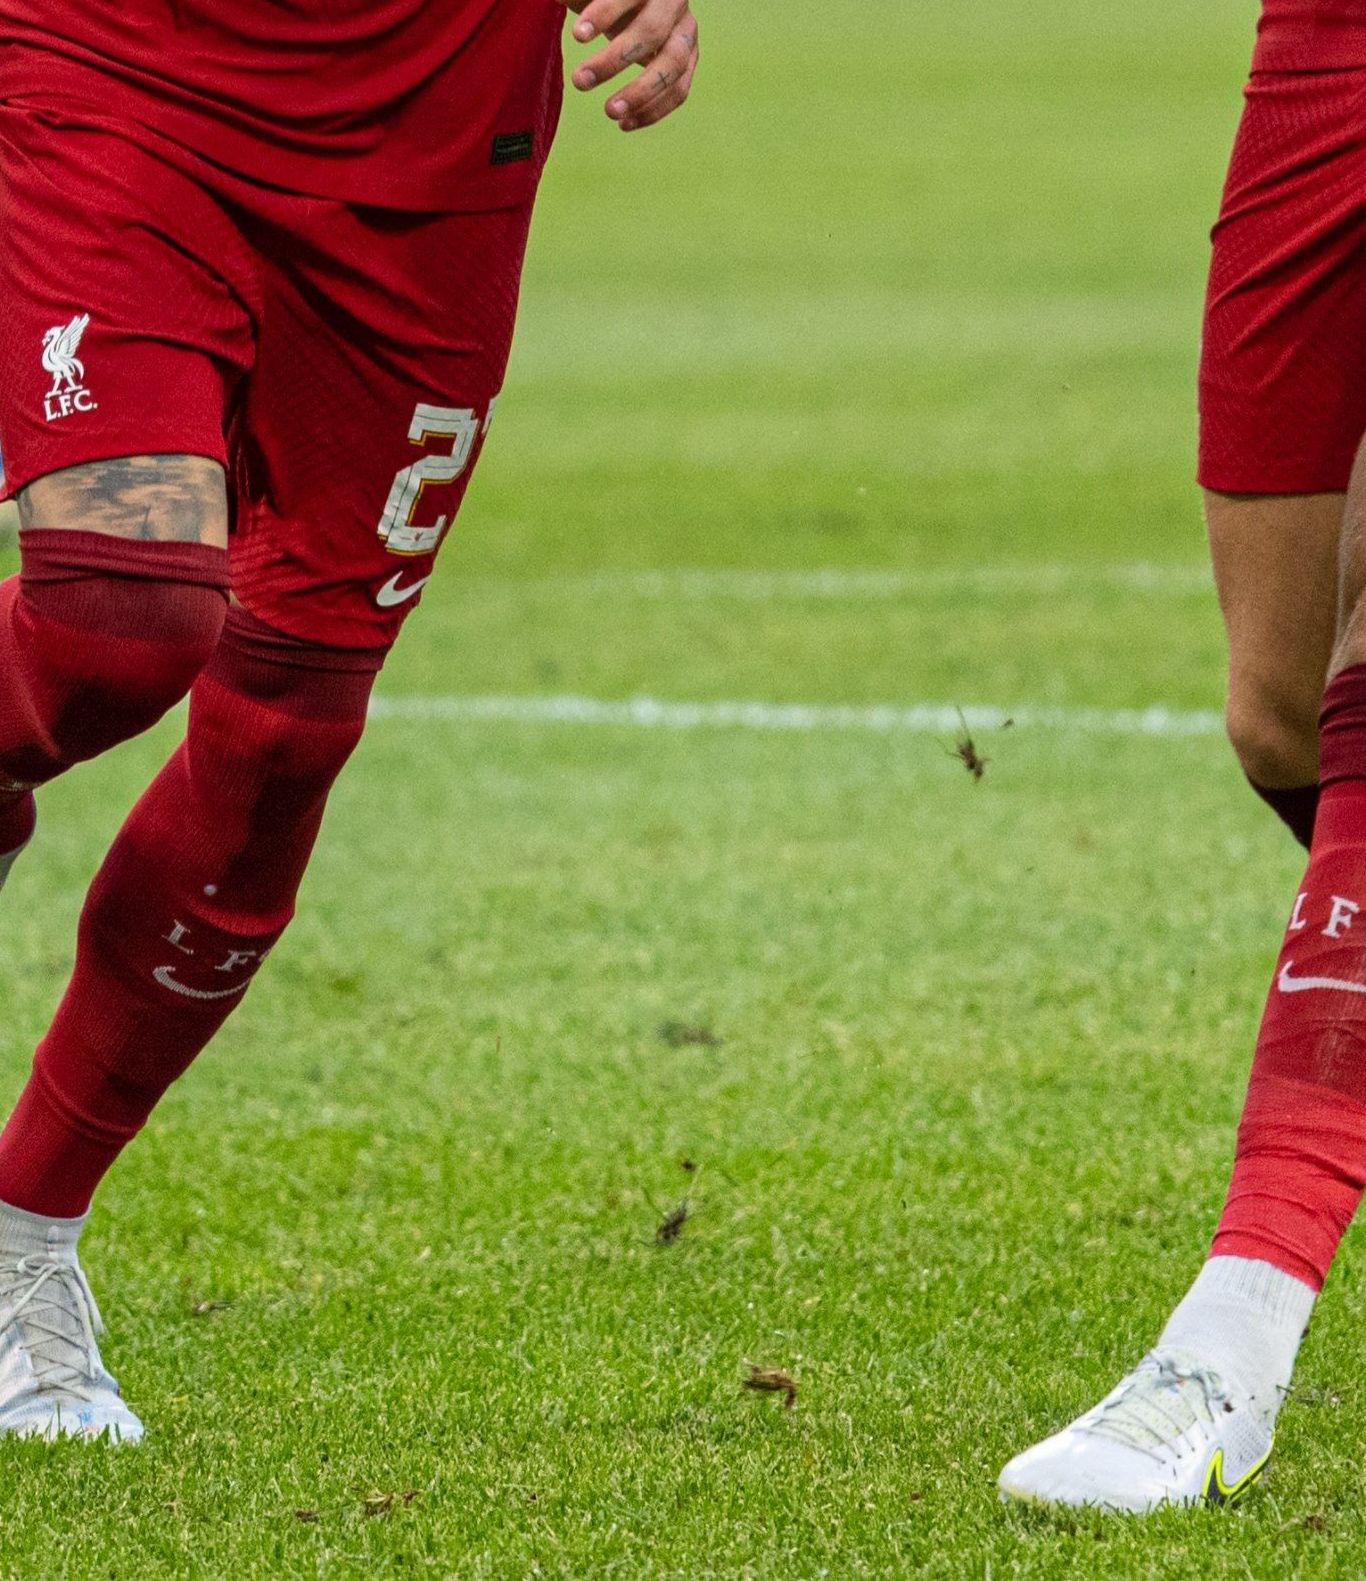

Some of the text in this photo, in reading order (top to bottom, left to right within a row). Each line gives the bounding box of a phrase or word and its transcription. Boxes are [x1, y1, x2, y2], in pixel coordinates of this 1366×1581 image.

[44, 389, 98, 422] L.F.C.
[377, 396, 497, 556] 2
[161, 919, 272, 972] LF
